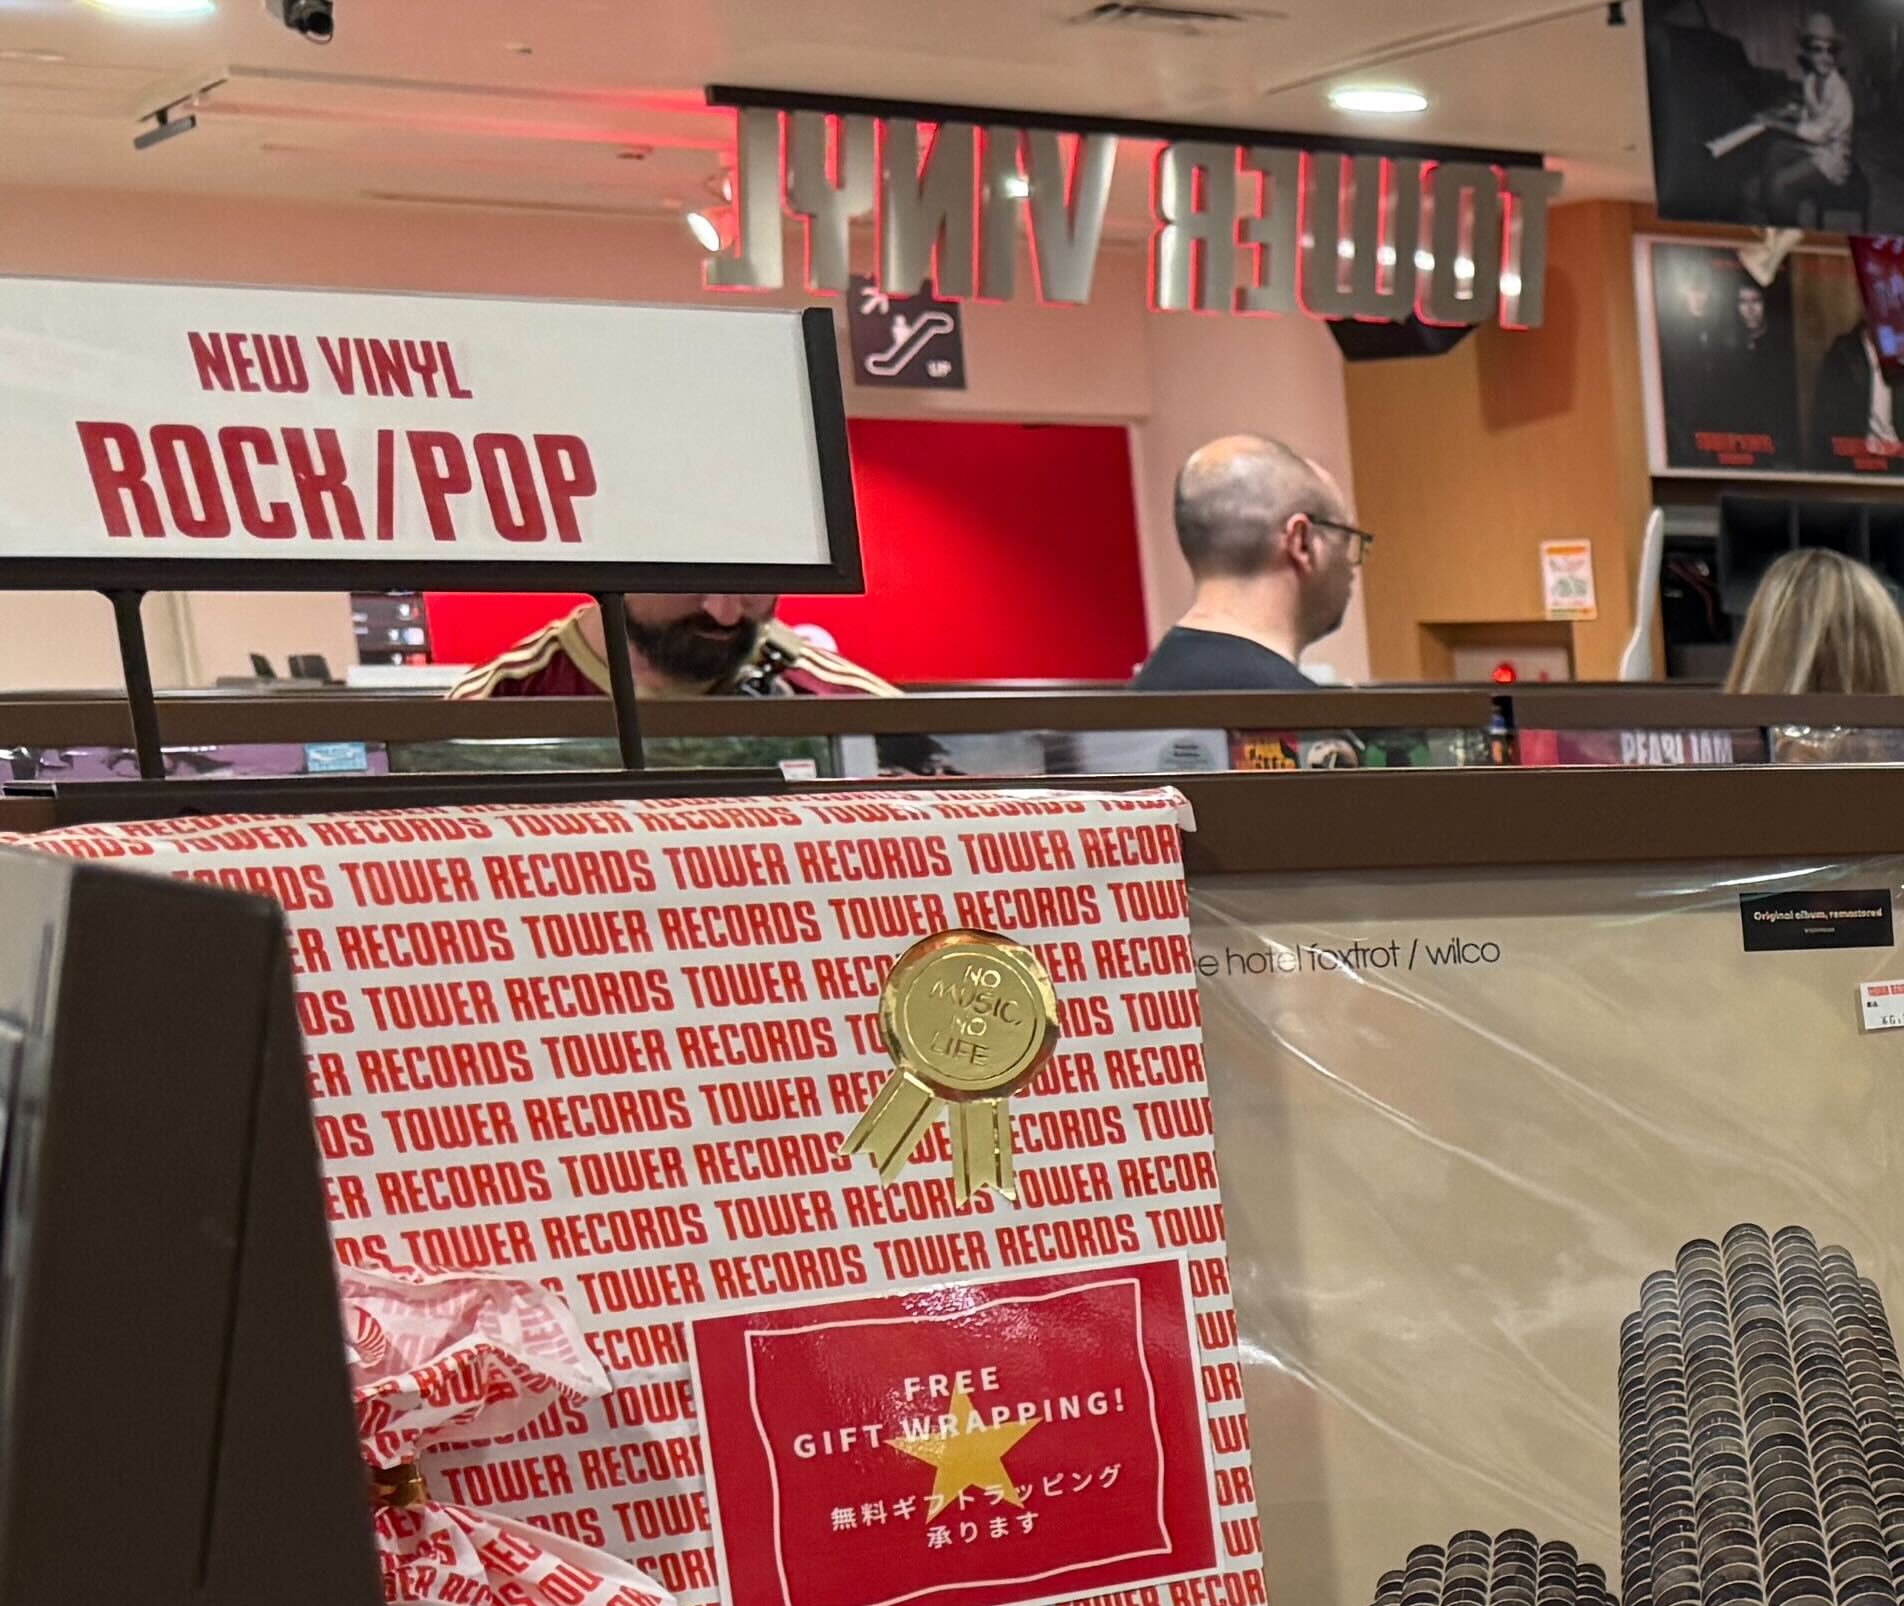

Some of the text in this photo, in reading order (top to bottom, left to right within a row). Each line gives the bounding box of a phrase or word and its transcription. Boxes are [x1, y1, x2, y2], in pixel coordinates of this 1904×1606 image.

[188, 332, 472, 399] NEW VINYL
[76, 421, 597, 544] ROCK/POP
[1621, 731, 1733, 765] PEARL JAM
[342, 832, 1073, 906] TOWER RECORDS RECORDS TOWER
[1753, 908, 1793, 920] Original
[963, 963, 1001, 988] NO
[1225, 943, 1302, 976] hotel
[1306, 939, 1400, 973] foxtrot
[1424, 937, 1500, 966] wilco
[952, 1016, 988, 1036] NO
[929, 1035, 989, 1066] LIFE
[904, 1365, 1001, 1402] FREE
[794, 1386, 1126, 1462] GIFT WRAPPING!
[830, 1462, 1122, 1532] 無料ギフトラッピング
[926, 1509, 1039, 1550] 承ります
